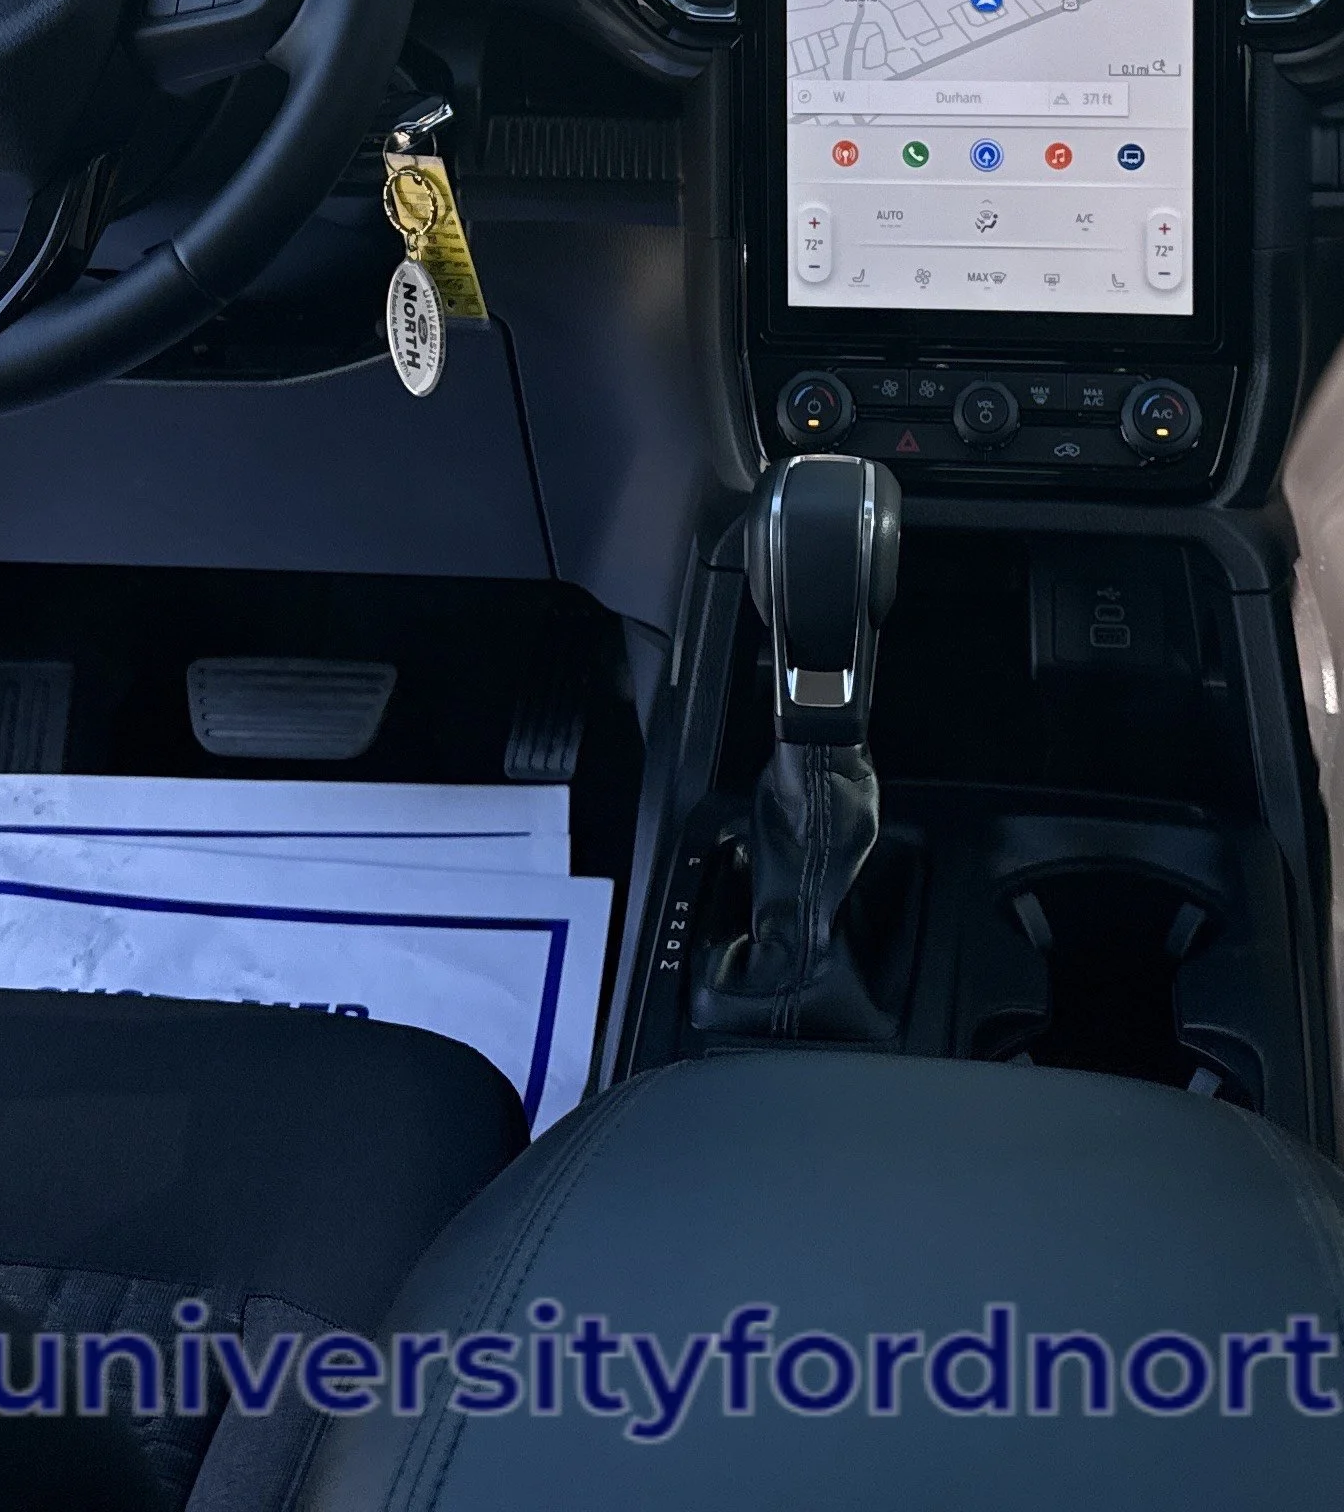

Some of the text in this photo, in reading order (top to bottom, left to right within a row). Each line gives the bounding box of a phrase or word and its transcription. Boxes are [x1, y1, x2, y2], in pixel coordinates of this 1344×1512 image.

[832, 91, 846, 103] W
[935, 91, 982, 104] Durham
[1101, 92, 1113, 105] ft
[876, 210, 904, 221] AUTO
[1075, 213, 1094, 224] A/C
[804, 239, 824, 251] 72°
[1154, 245, 1174, 257] 72°
[967, 272, 989, 283] MAX
[403, 282, 421, 370] NORTH
[422, 289, 438, 371] UNIVERSITY
[1083, 388, 1104, 397] MAX
[976, 400, 995, 409] VOL
[1083, 397, 1105, 407] A/C
[1151, 409, 1174, 420] A/C
[675, 901, 689, 911] R
[670, 920, 686, 930] N
[666, 940, 681, 950] D
[659, 960, 680, 970] M
